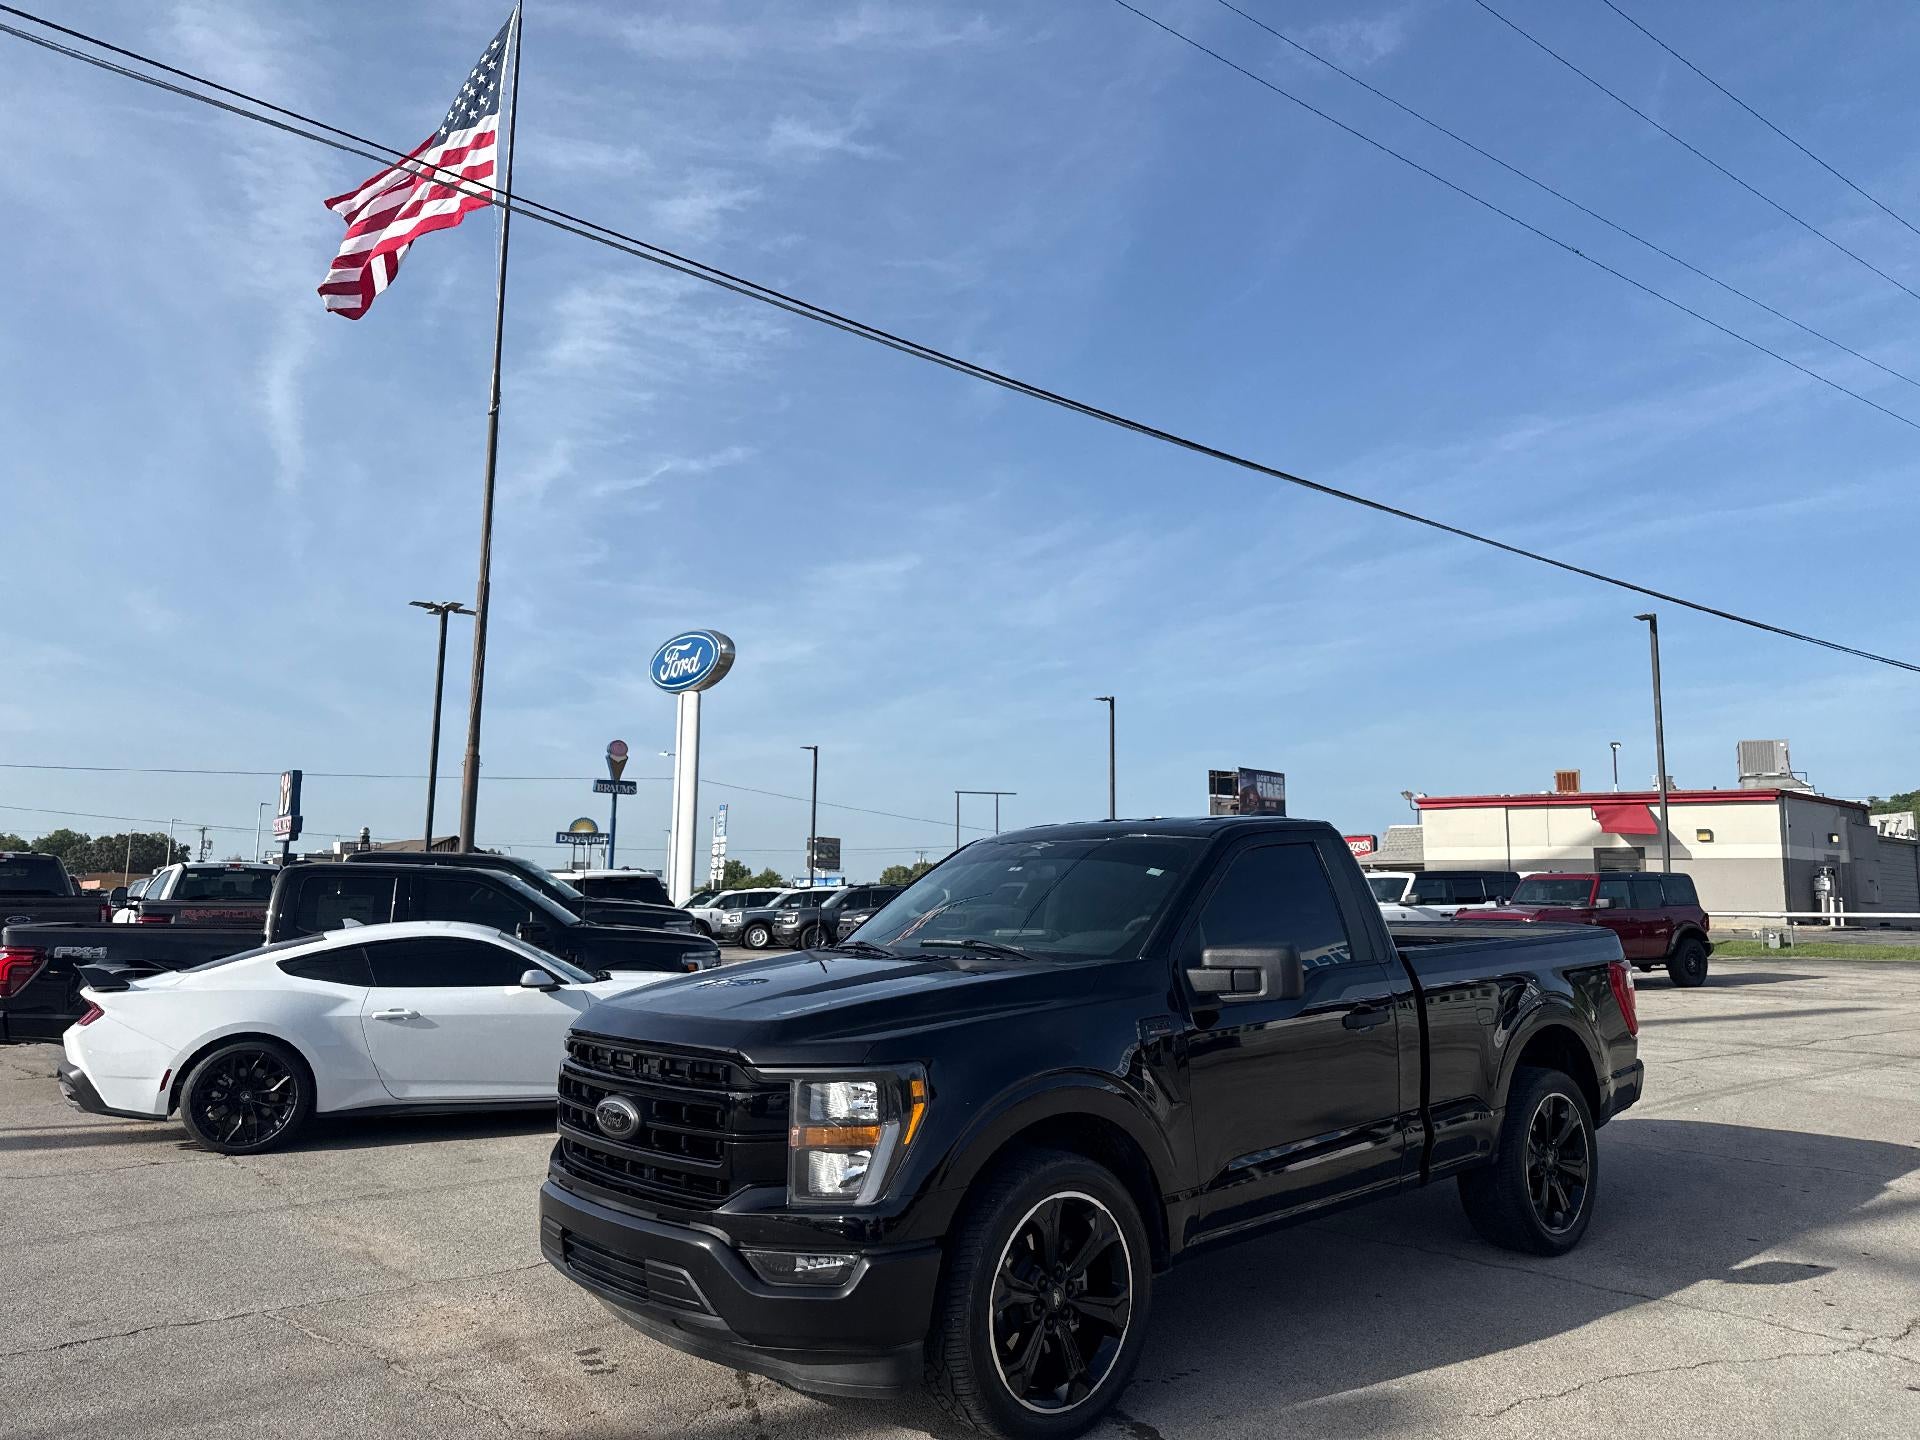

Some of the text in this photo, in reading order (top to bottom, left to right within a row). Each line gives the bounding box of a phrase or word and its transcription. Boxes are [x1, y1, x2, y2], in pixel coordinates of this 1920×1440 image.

[660, 642, 703, 681] Ford
[181, 909, 266, 921] RAPTOR
[54, 946, 107, 959] FX4
